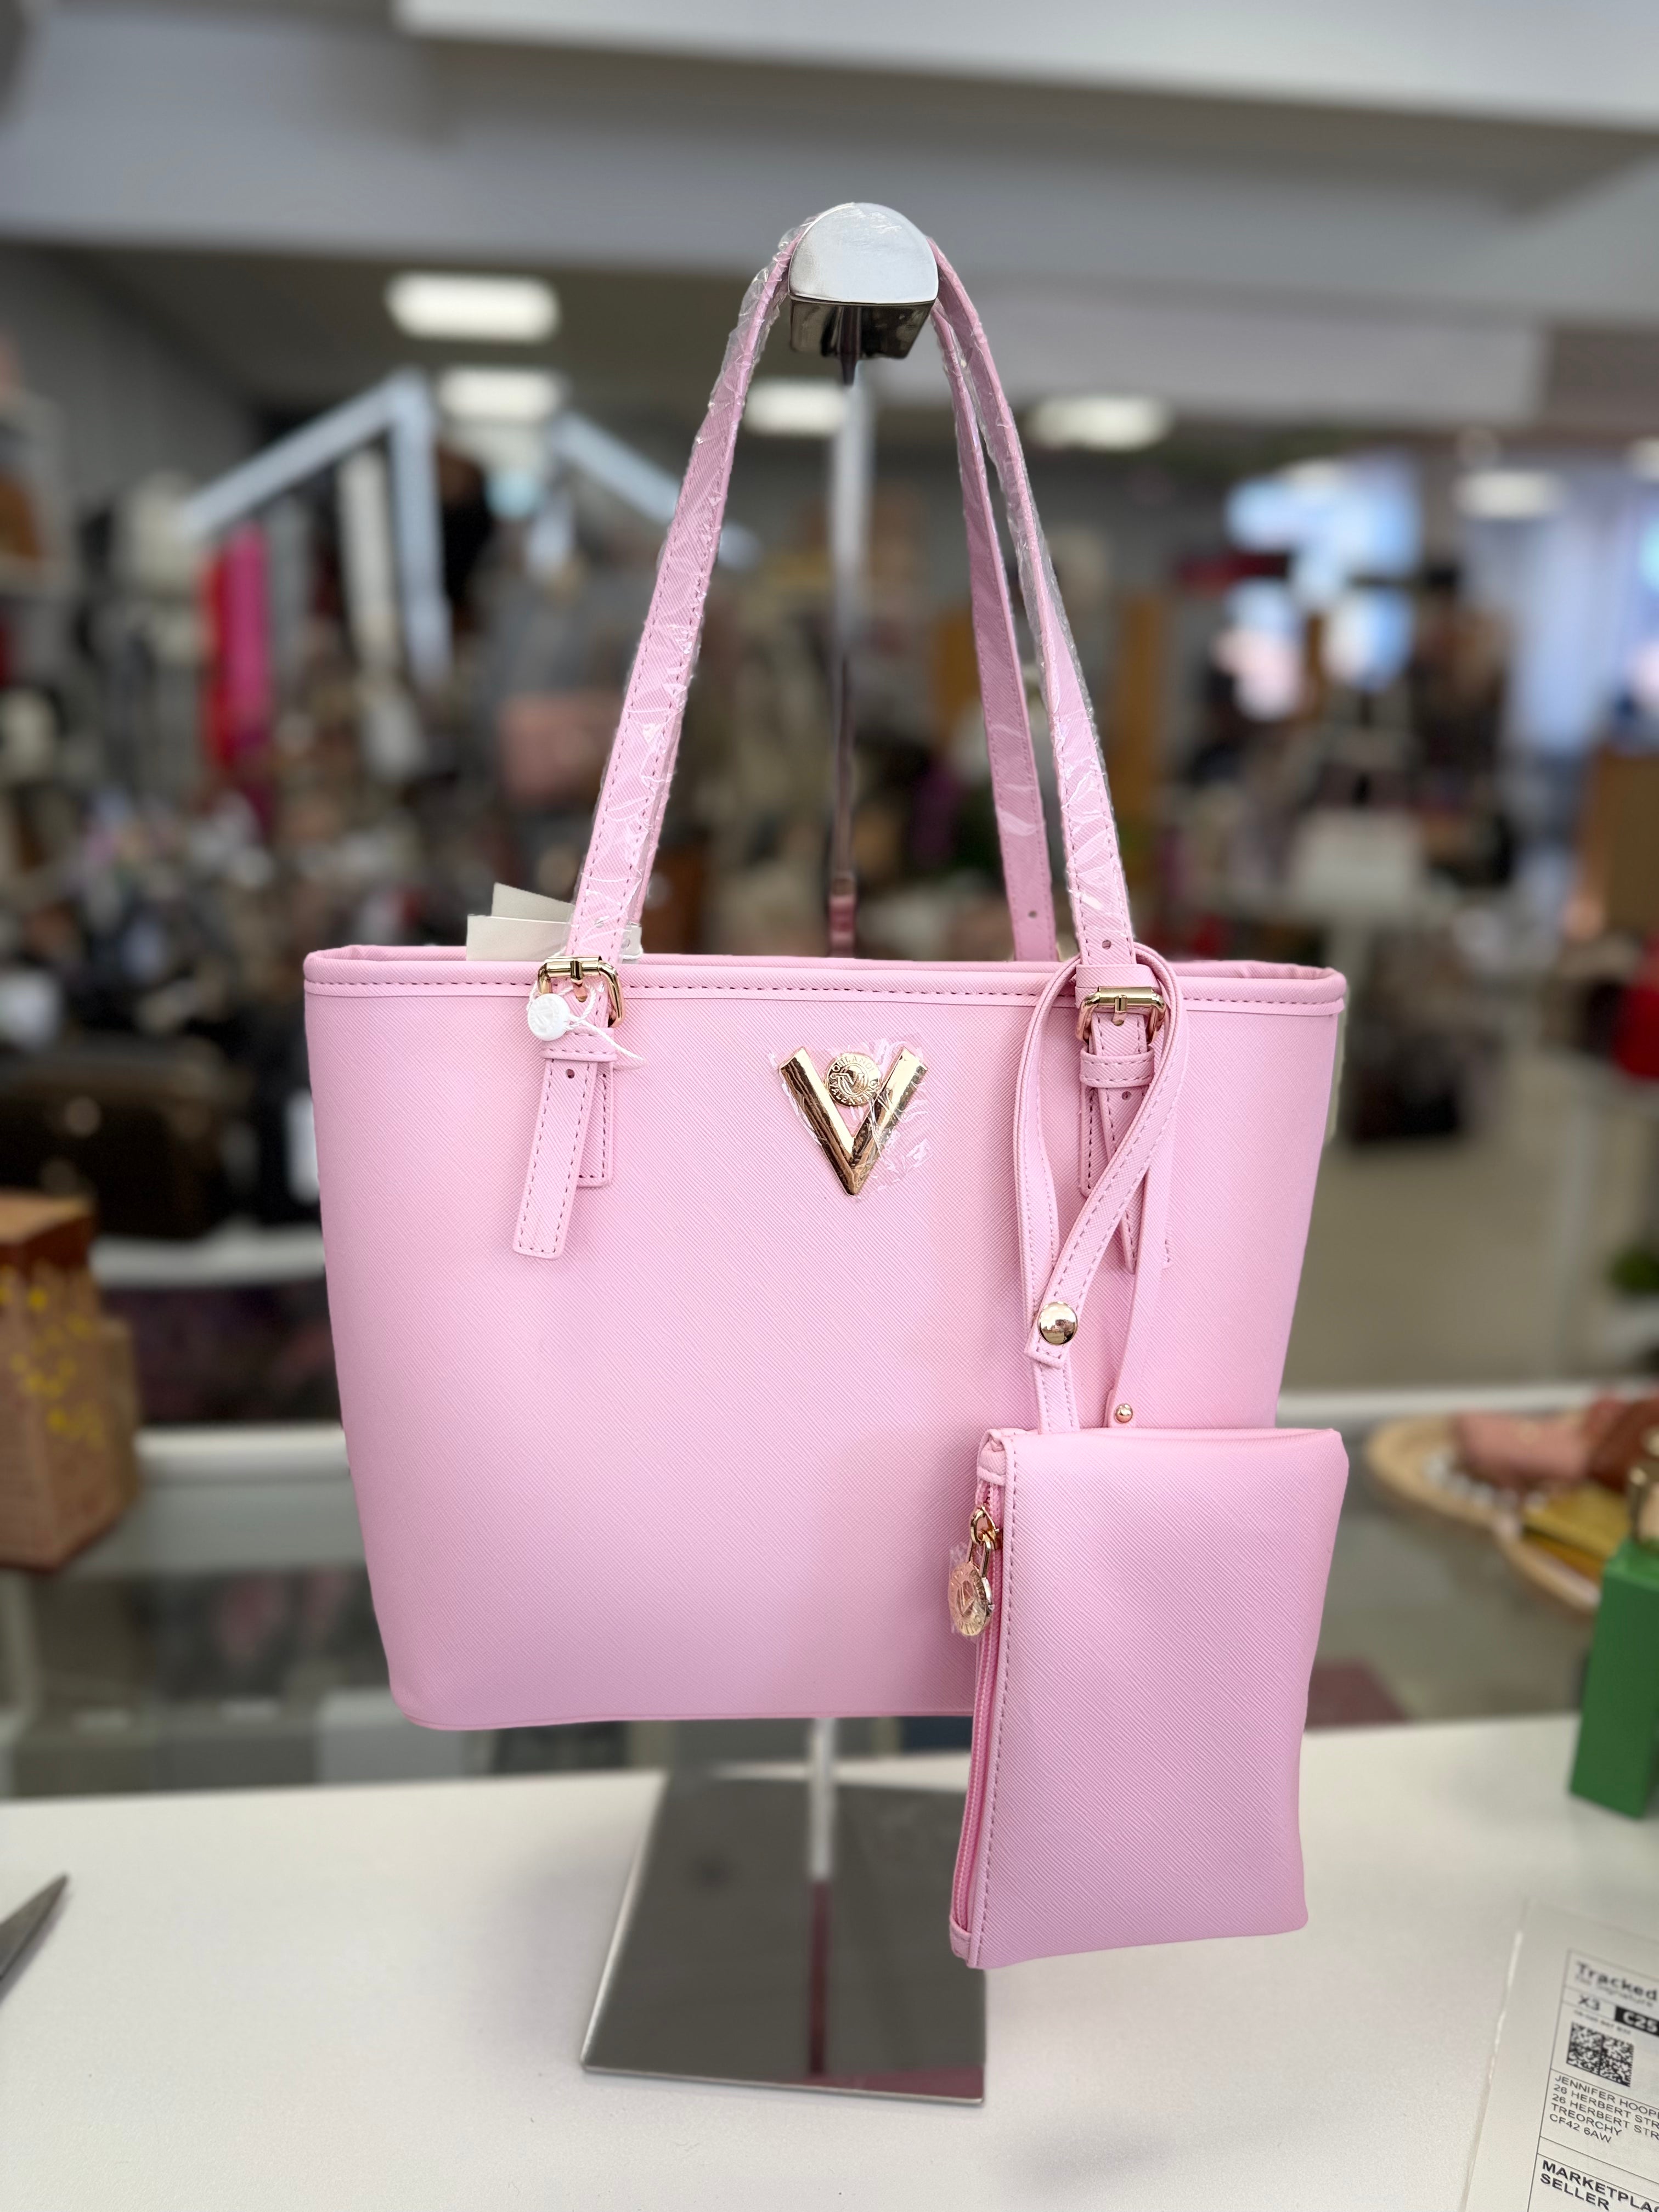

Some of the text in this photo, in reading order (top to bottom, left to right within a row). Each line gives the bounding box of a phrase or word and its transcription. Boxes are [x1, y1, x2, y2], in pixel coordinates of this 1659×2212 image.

[1577, 1961, 1657, 2001] Tracked
[1552, 2093, 1566, 2104] 26
[1570, 2100, 1630, 2128] HERBERT
[1553, 2084, 1567, 2095] 26
[1571, 2090, 1632, 2118] HERBERT
[1555, 2075, 1659, 2119] JENNIFER HOOP
[1549, 2113, 1612, 2143] CF42 6AW
[1551, 2102, 1622, 2136] TREORCHY
[1540, 2173, 1610, 2211] SELLER
